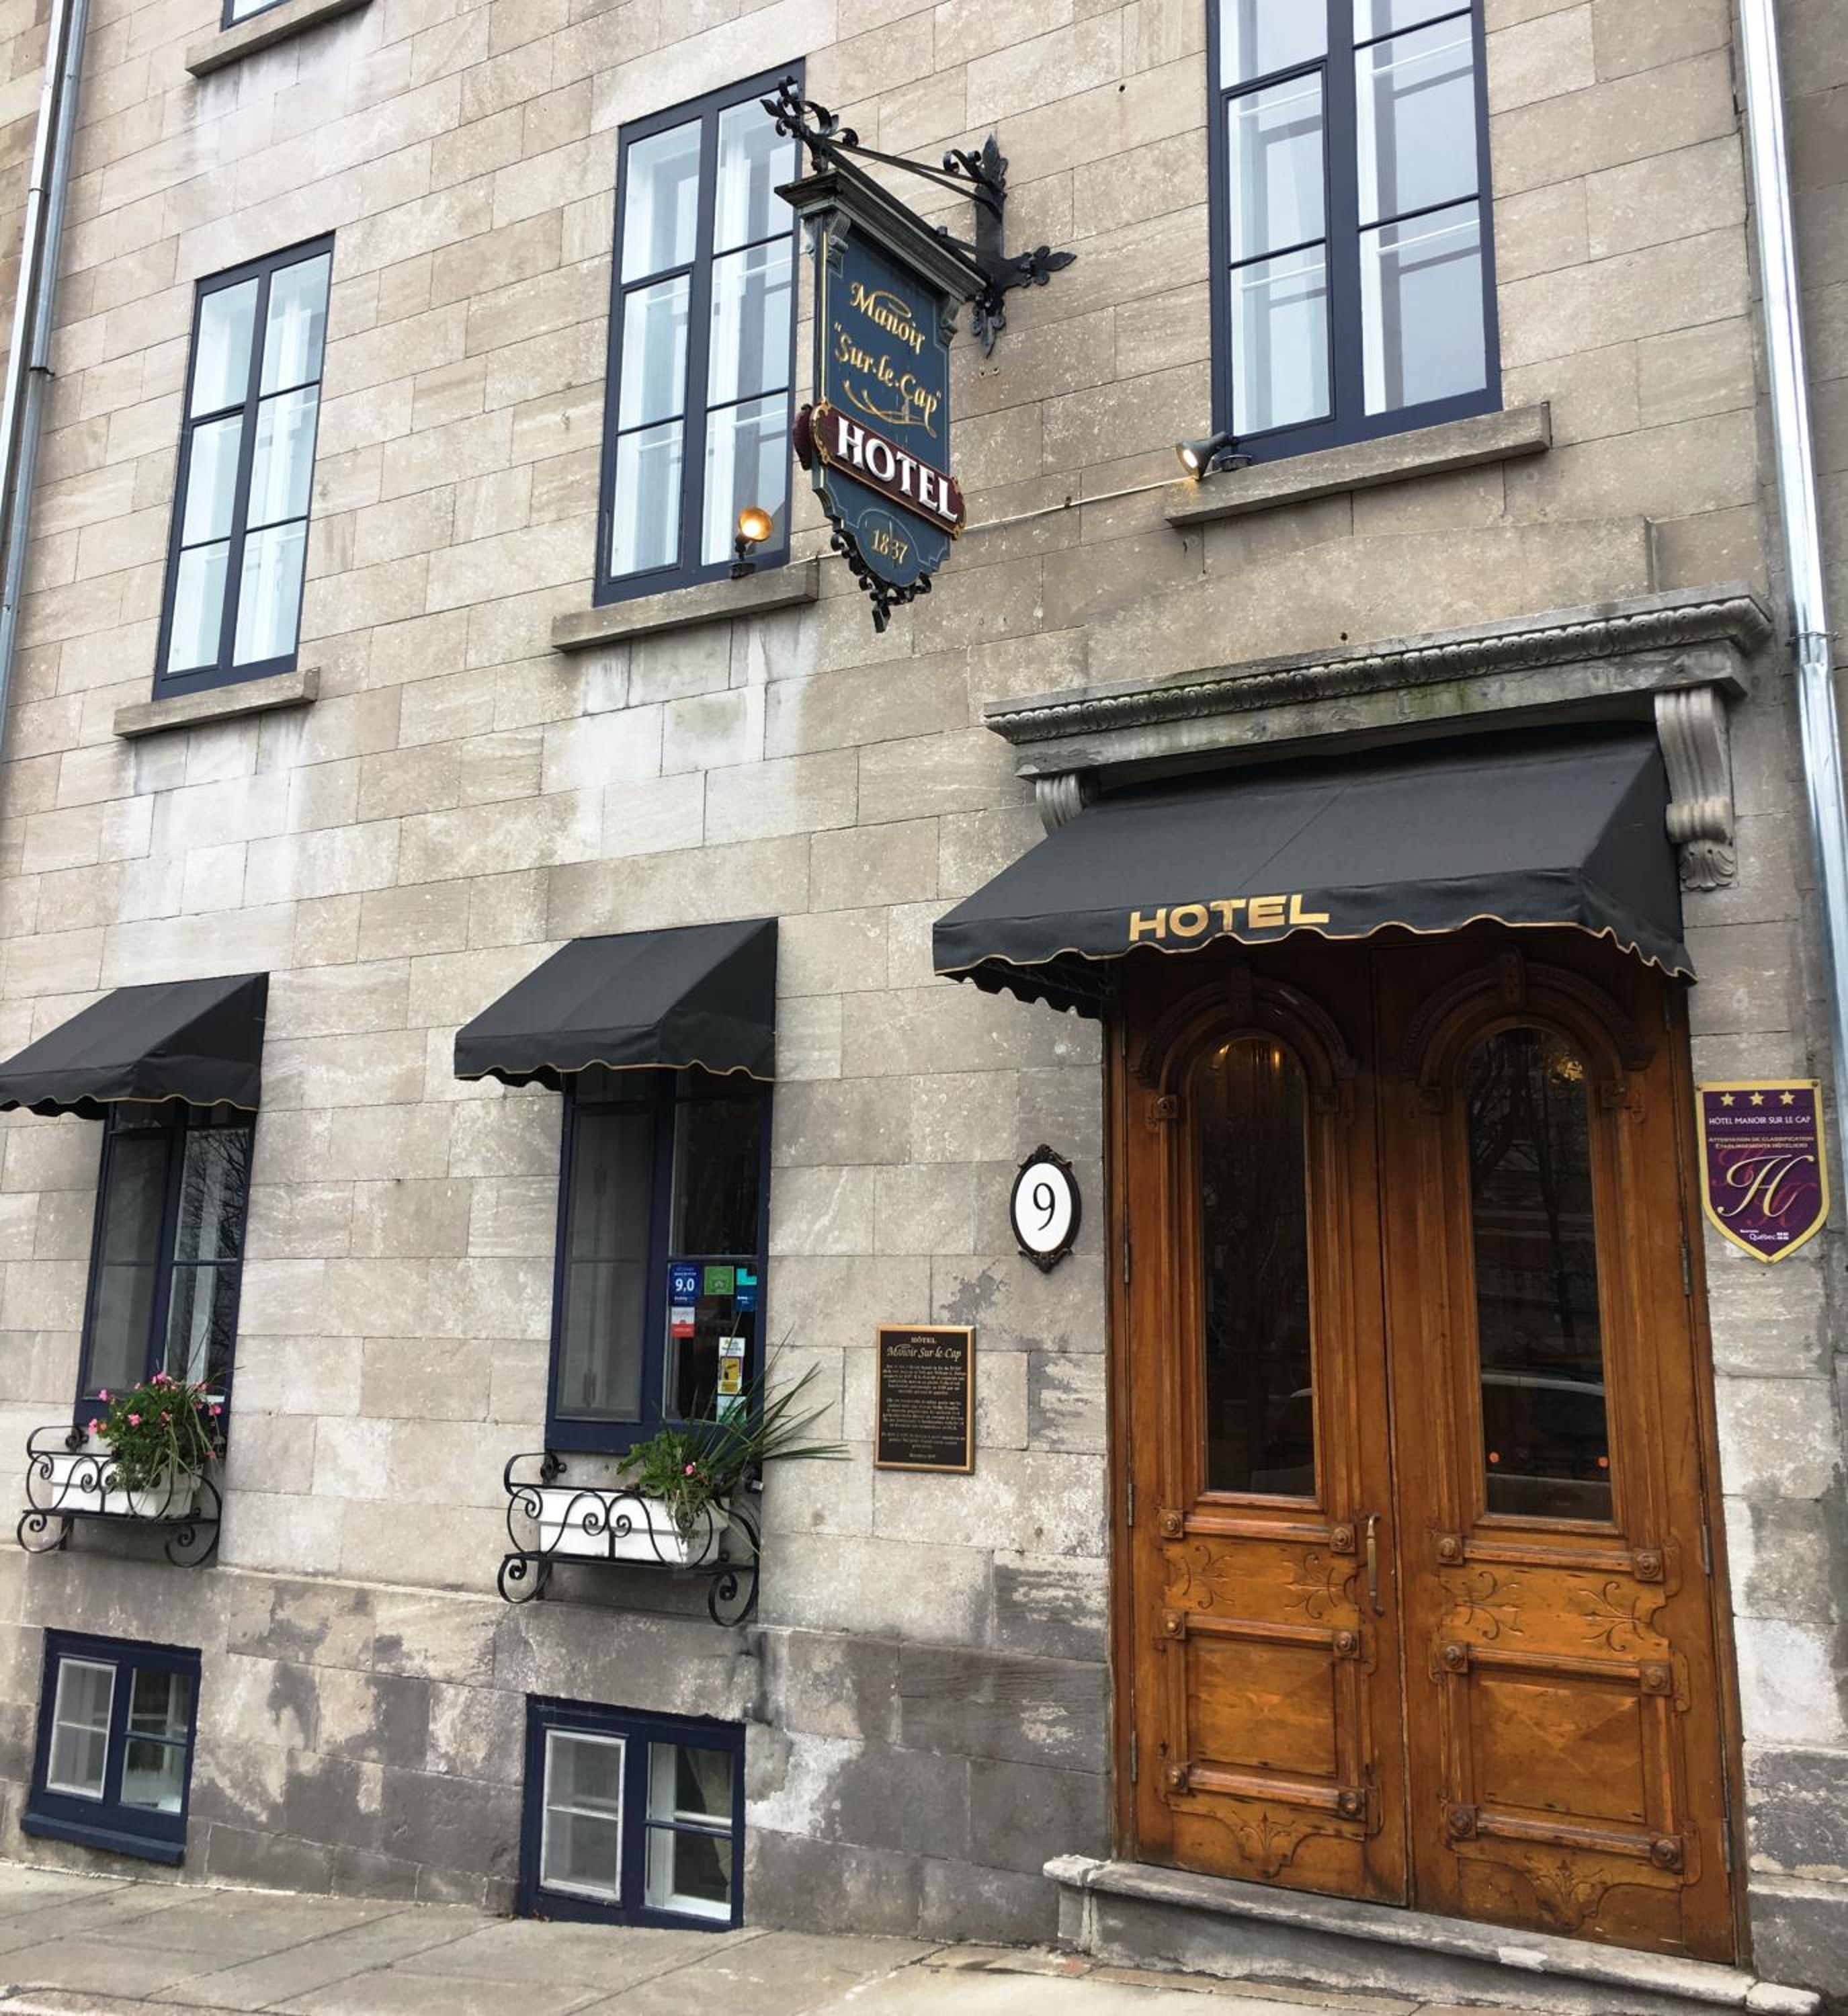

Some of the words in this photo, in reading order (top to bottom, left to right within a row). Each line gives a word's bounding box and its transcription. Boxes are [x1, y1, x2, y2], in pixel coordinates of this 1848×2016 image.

[849, 282, 925, 355] Manoir
[837, 416, 958, 523] HOTEL
[872, 529, 908, 565] 1837
[1129, 894, 1330, 941] HOTEL
[1734, 1116, 1767, 1124] MANOIR
[1768, 1116, 1783, 1124] SUR
[1785, 1116, 1793, 1124] LE
[1795, 1116, 1811, 1124] CAP
[1033, 1183, 1056, 1231] 9
[675, 1278, 695, 1292] 9,0
[918, 1347, 934, 1358] Sur
[945, 1348, 962, 1362] Cap
